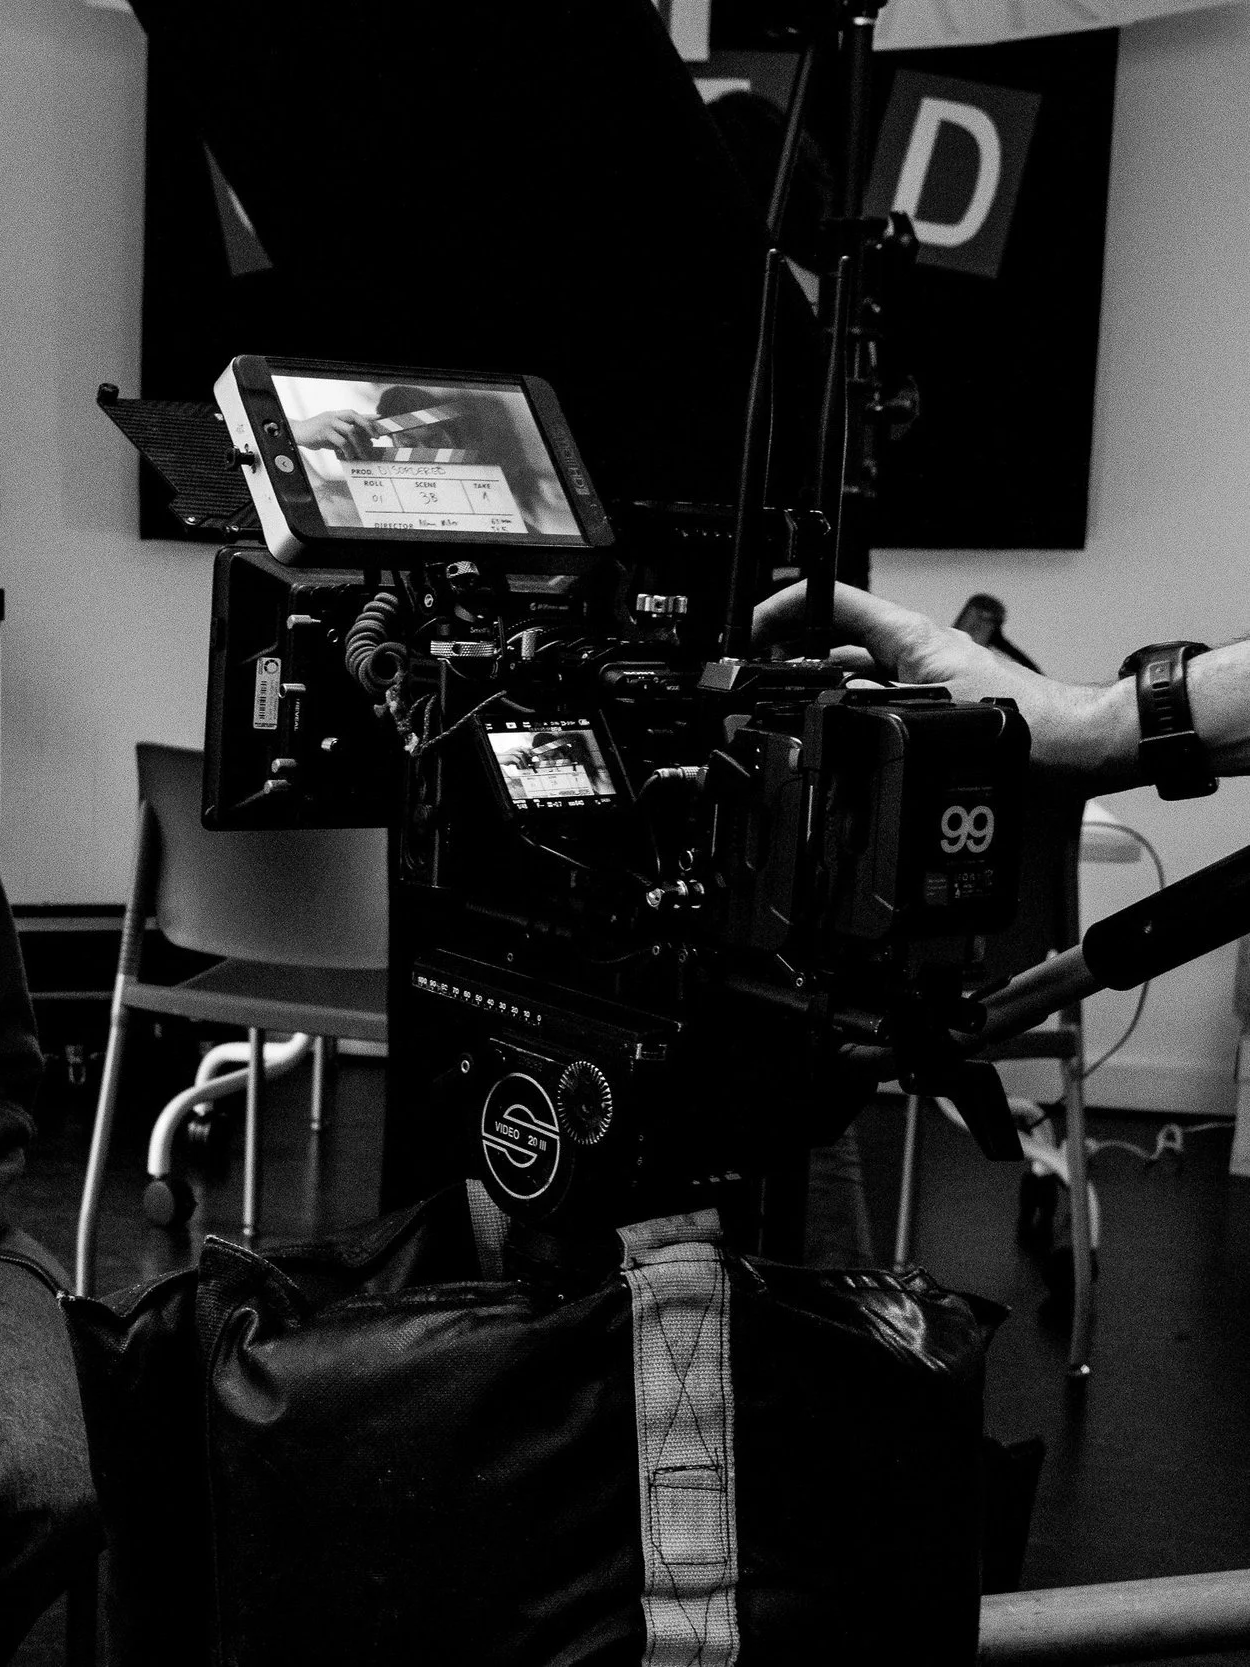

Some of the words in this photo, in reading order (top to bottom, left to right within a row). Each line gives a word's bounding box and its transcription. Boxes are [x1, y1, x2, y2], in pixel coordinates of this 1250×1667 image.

[891, 96, 1002, 248] D
[414, 481, 438, 489] SCENE
[940, 805, 995, 854] 99
[452, 986, 460, 995] 70
[475, 994, 483, 1002] 50
[486, 998, 495, 1006] 40
[498, 1001, 507, 1010] 30
[510, 1005, 519, 1014] 20
[523, 1010, 531, 1018] 10
[536, 1014, 542, 1022] 0
[494, 1121, 520, 1140] VIDEO
[527, 1134, 538, 1147] 20
[539, 1139, 547, 1152] III
